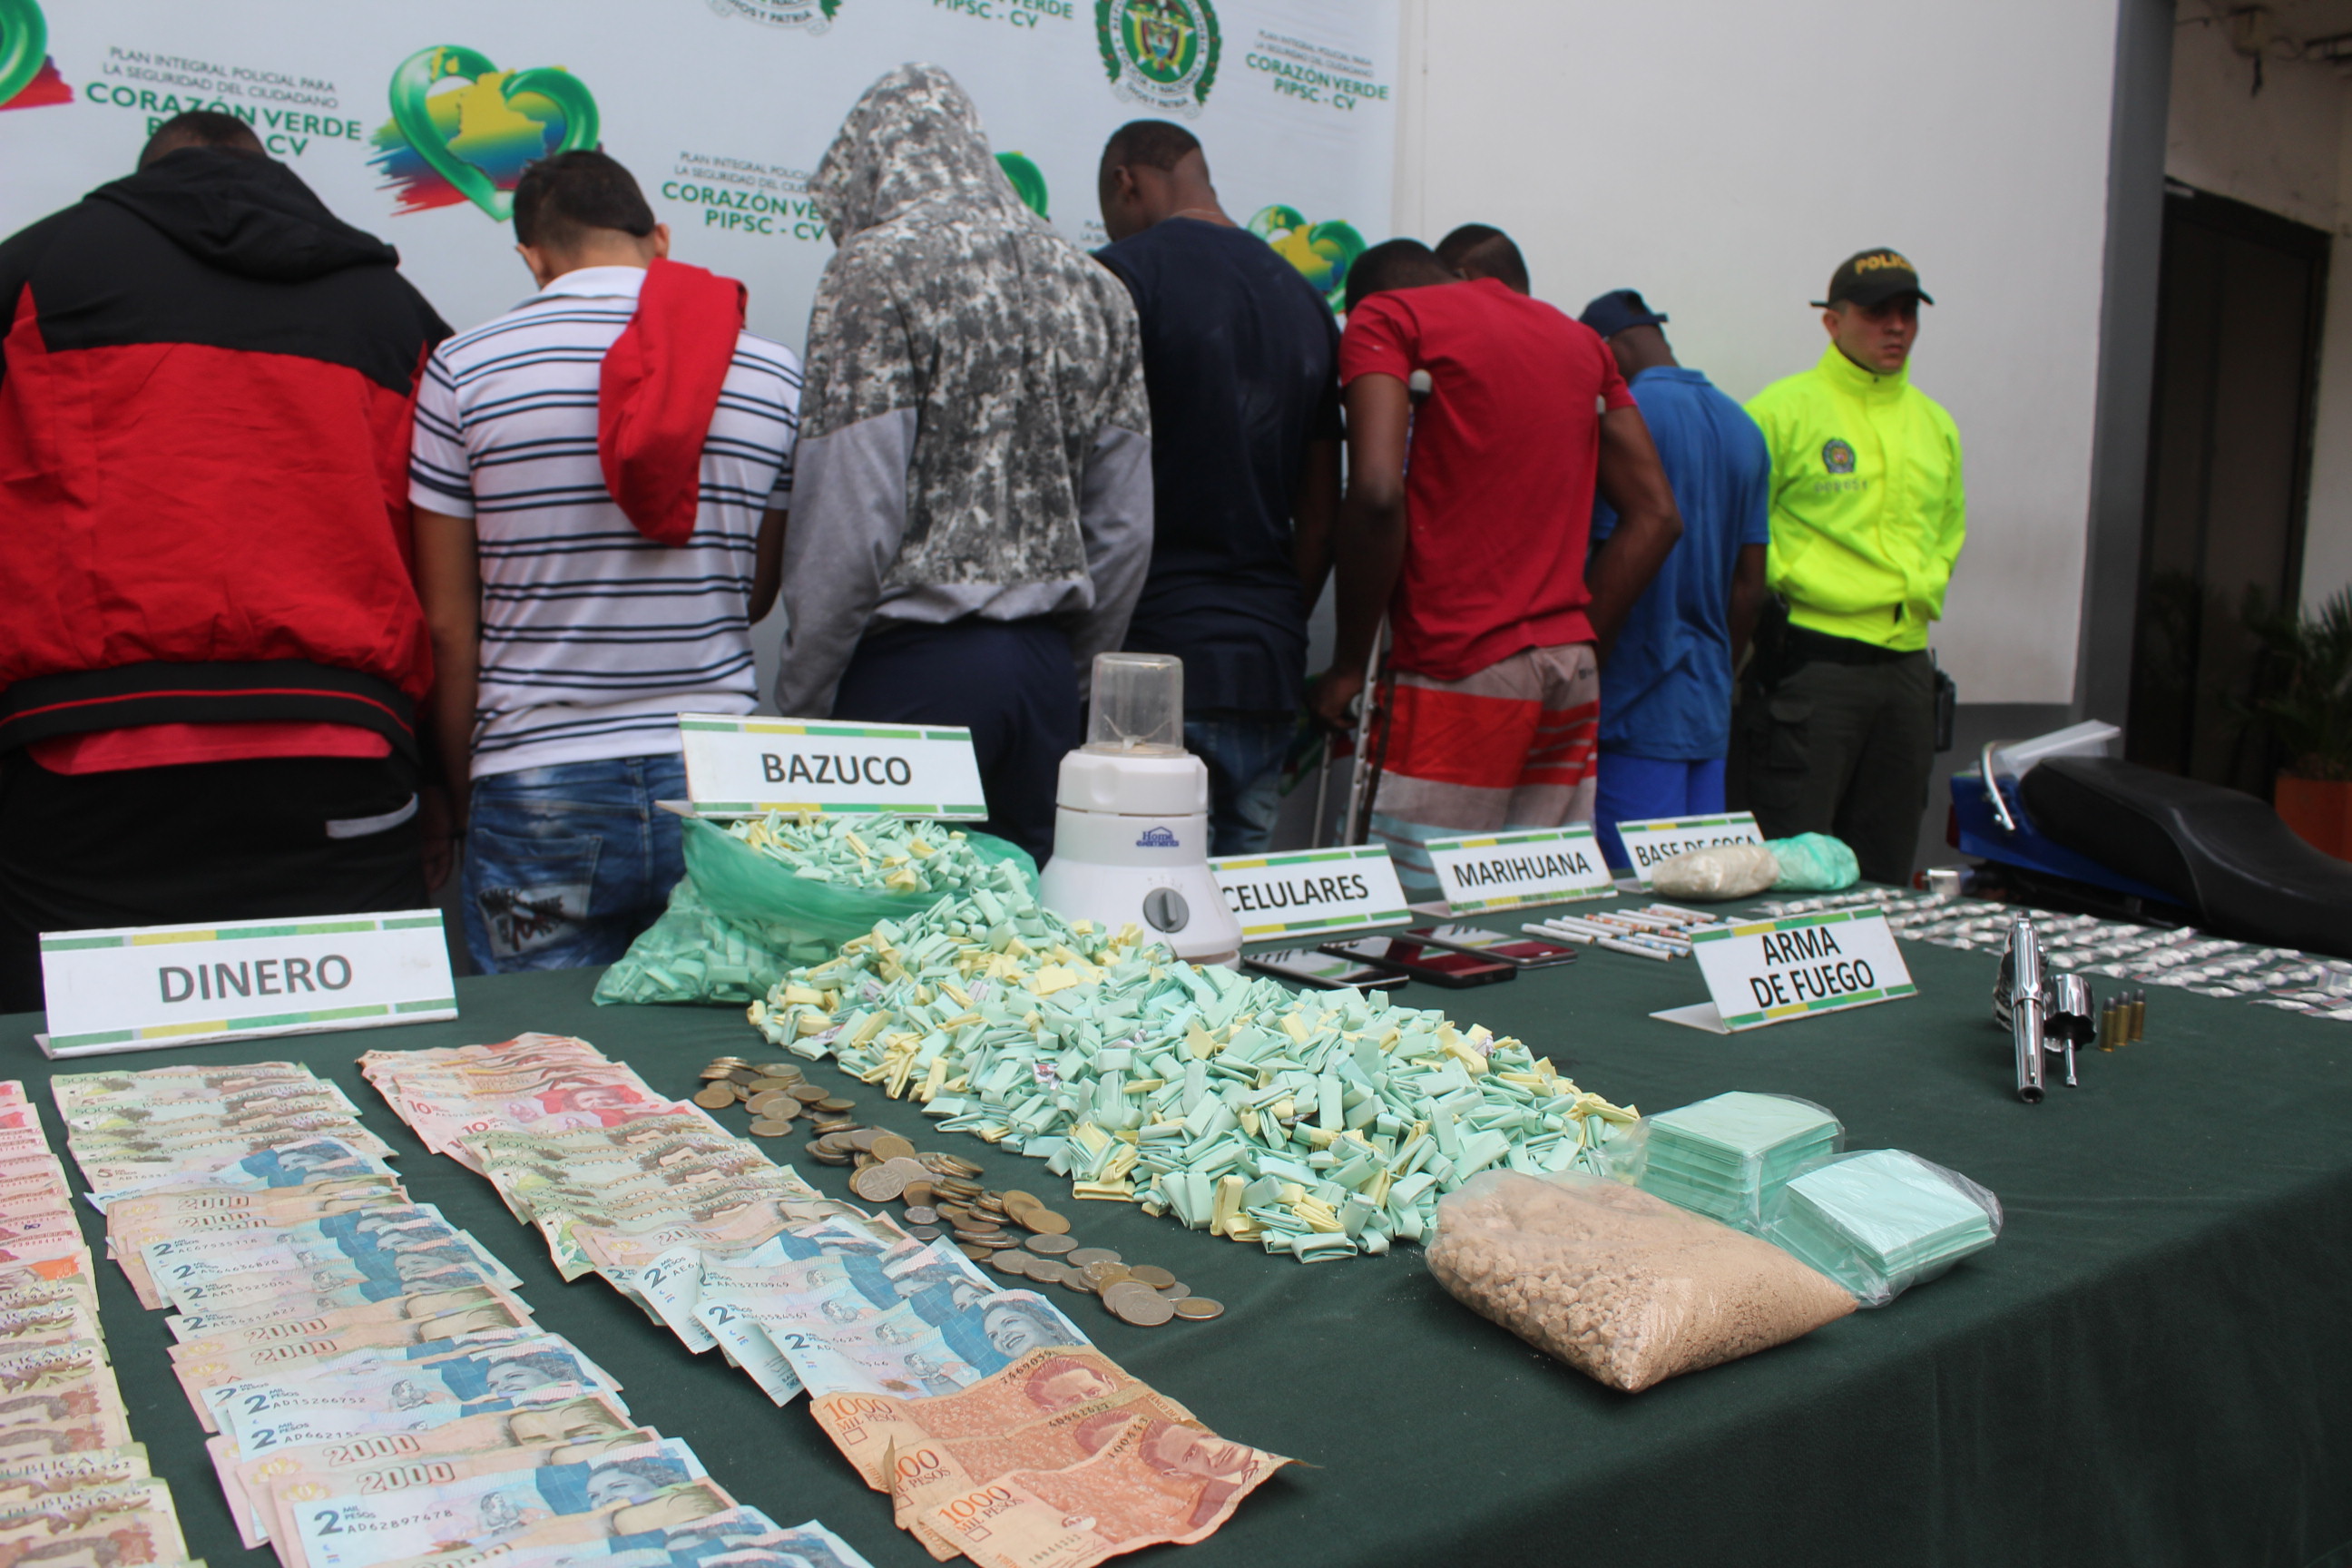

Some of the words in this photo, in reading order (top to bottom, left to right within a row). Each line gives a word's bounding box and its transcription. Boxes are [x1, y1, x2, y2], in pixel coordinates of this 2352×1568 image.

[1010, 9, 1038, 29] CV
[110, 46, 151, 64] PLAN
[153, 55, 227, 77] INTEGRAL
[231, 67, 295, 87] POLICIAL
[300, 78, 336, 93] PARA
[1246, 53, 1330, 88] CORAZÓN
[1332, 75, 1389, 100] VERDE
[103, 62, 122, 76] LA
[125, 67, 212, 91] SEGURIDAD
[217, 81, 243, 97] DEL
[248, 85, 338, 109] CIUDADANO
[1274, 77, 1319, 103] PIPSC
[1333, 93, 1357, 111] CV
[262, 107, 362, 141] VERDE
[265, 133, 309, 157] CV
[674, 165, 688, 175] LA
[692, 167, 756, 186] SEGURIDAD
[758, 177, 779, 189] DEL
[681, 151, 710, 164] PLAN
[712, 156, 767, 174] INTEGRAL
[770, 165, 813, 181] POLICI
[662, 181, 789, 217] CORAZÓN
[705, 209, 773, 235] PIPSC
[793, 221, 827, 241] CV
[761, 752, 913, 787] BAZUCO
[1634, 840, 1681, 867] BASE
[1453, 851, 1593, 888] MARIHUANA
[1221, 874, 1368, 913] CELULARES
[1761, 926, 1841, 966] ARMA
[159, 954, 353, 1003] DINERO
[1749, 974, 1791, 1008] DE
[1789, 959, 1876, 1002] FUEGO
[407, 1099, 433, 1116] 10
[461, 1122, 490, 1135] 10
[497, 1140, 545, 1151] 5000
[96, 1168, 114, 1179] 5
[491, 1158, 539, 1168] 5000
[178, 1196, 250, 1211] 2000
[153, 1243, 175, 1258] 2
[663, 1256, 688, 1271] PESOS
[172, 1264, 196, 1280] 2
[643, 1267, 669, 1289] 2
[660, 1257, 673, 1268] MIL
[183, 1287, 208, 1301] 2
[183, 1316, 209, 1332] 2
[708, 1305, 737, 1327] 2
[243, 1318, 328, 1345] 2000
[784, 1332, 811, 1351] 2
[250, 1339, 338, 1367] 2000
[243, 1394, 271, 1416] 2
[823, 1396, 894, 1423] 1000
[279, 1422, 310, 1435] PESOS
[836, 1416, 864, 1433] MIL
[250, 1428, 278, 1451] 2
[322, 1433, 421, 1468] 2000
[356, 1462, 456, 1496] 2000
[908, 1465, 952, 1488] PESOS
[345, 1512, 377, 1521] PESOS
[938, 1485, 1012, 1525] 1000
[956, 1515, 985, 1534] MIL
[986, 1497, 1024, 1519] PESOS
[313, 1509, 344, 1537] 2
[342, 1504, 359, 1514] MIL
